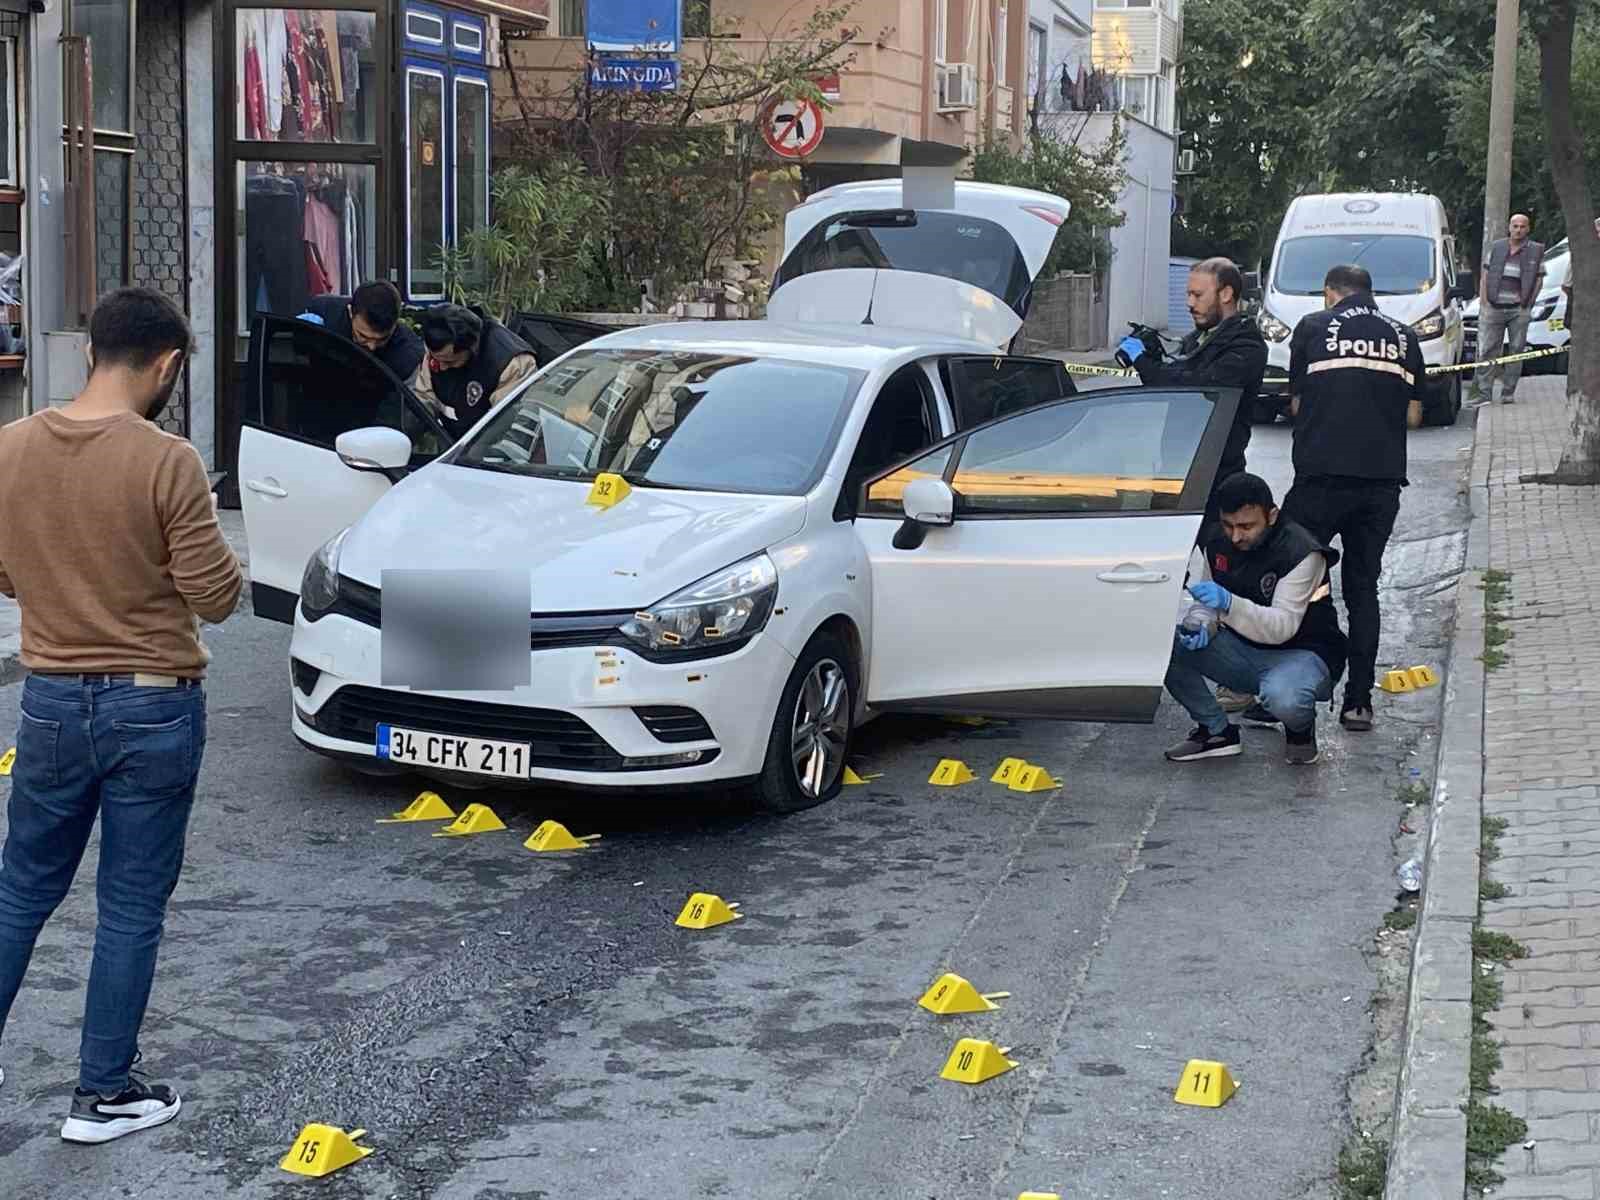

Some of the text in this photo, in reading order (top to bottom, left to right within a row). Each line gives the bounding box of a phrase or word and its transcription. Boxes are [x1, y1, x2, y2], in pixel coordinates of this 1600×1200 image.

[1325, 318, 1342, 352] OLAY
[597, 481, 611, 496] 32
[392, 732, 417, 761] 34
[427, 737, 468, 768] CFK
[479, 744, 522, 774] 211
[940, 766, 950, 779] 7
[689, 903, 705, 920] 16
[957, 1049, 974, 1071] 10
[1194, 1071, 1211, 1094] 11
[299, 1140, 320, 1164] 15
